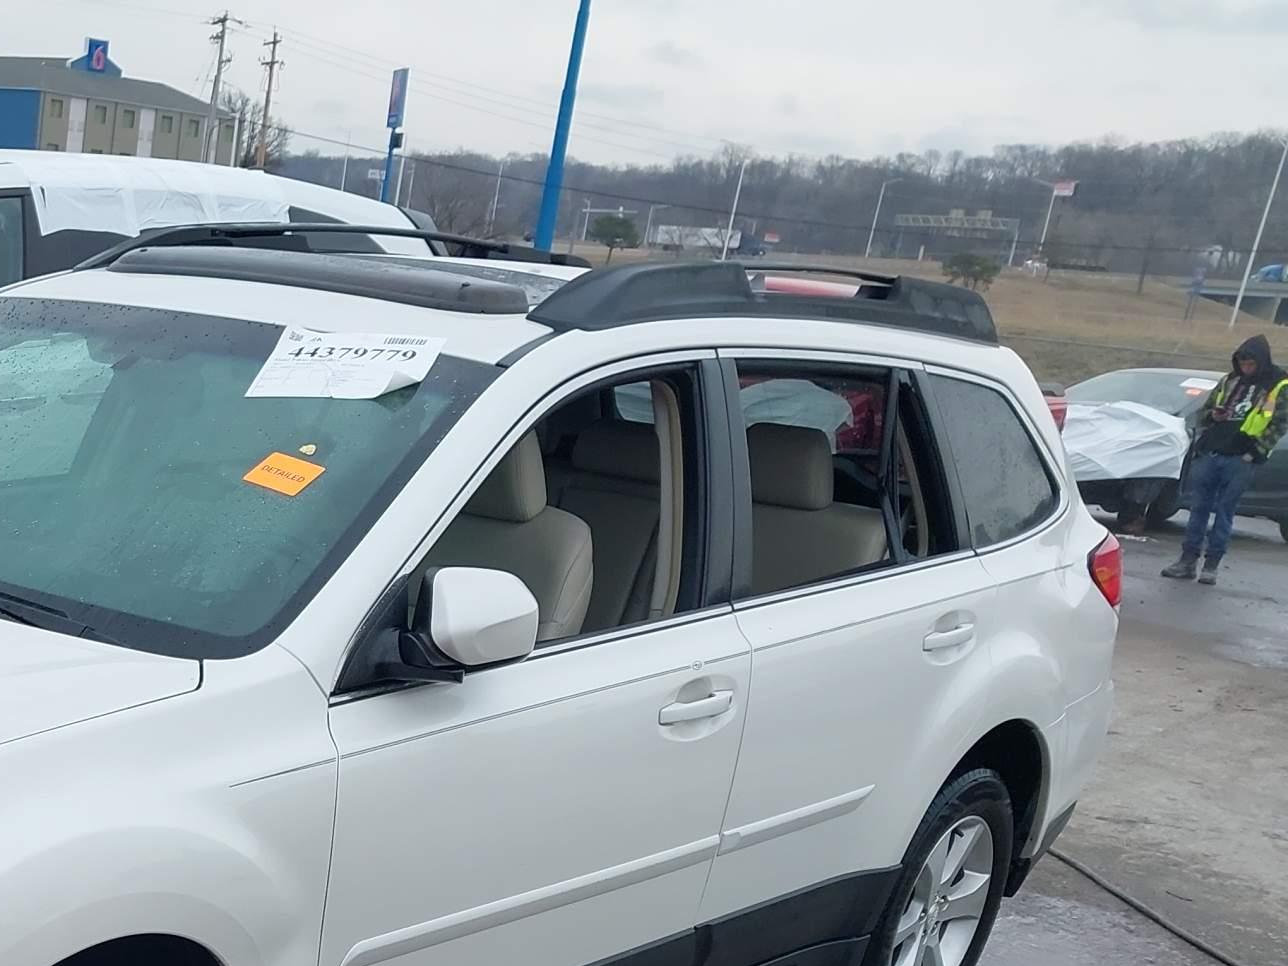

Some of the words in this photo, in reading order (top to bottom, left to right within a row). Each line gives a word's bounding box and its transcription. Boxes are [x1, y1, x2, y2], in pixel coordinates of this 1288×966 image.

[92, 45, 105, 70] 6
[287, 345, 418, 362] 44379779
[261, 464, 306, 483] DETAILED
